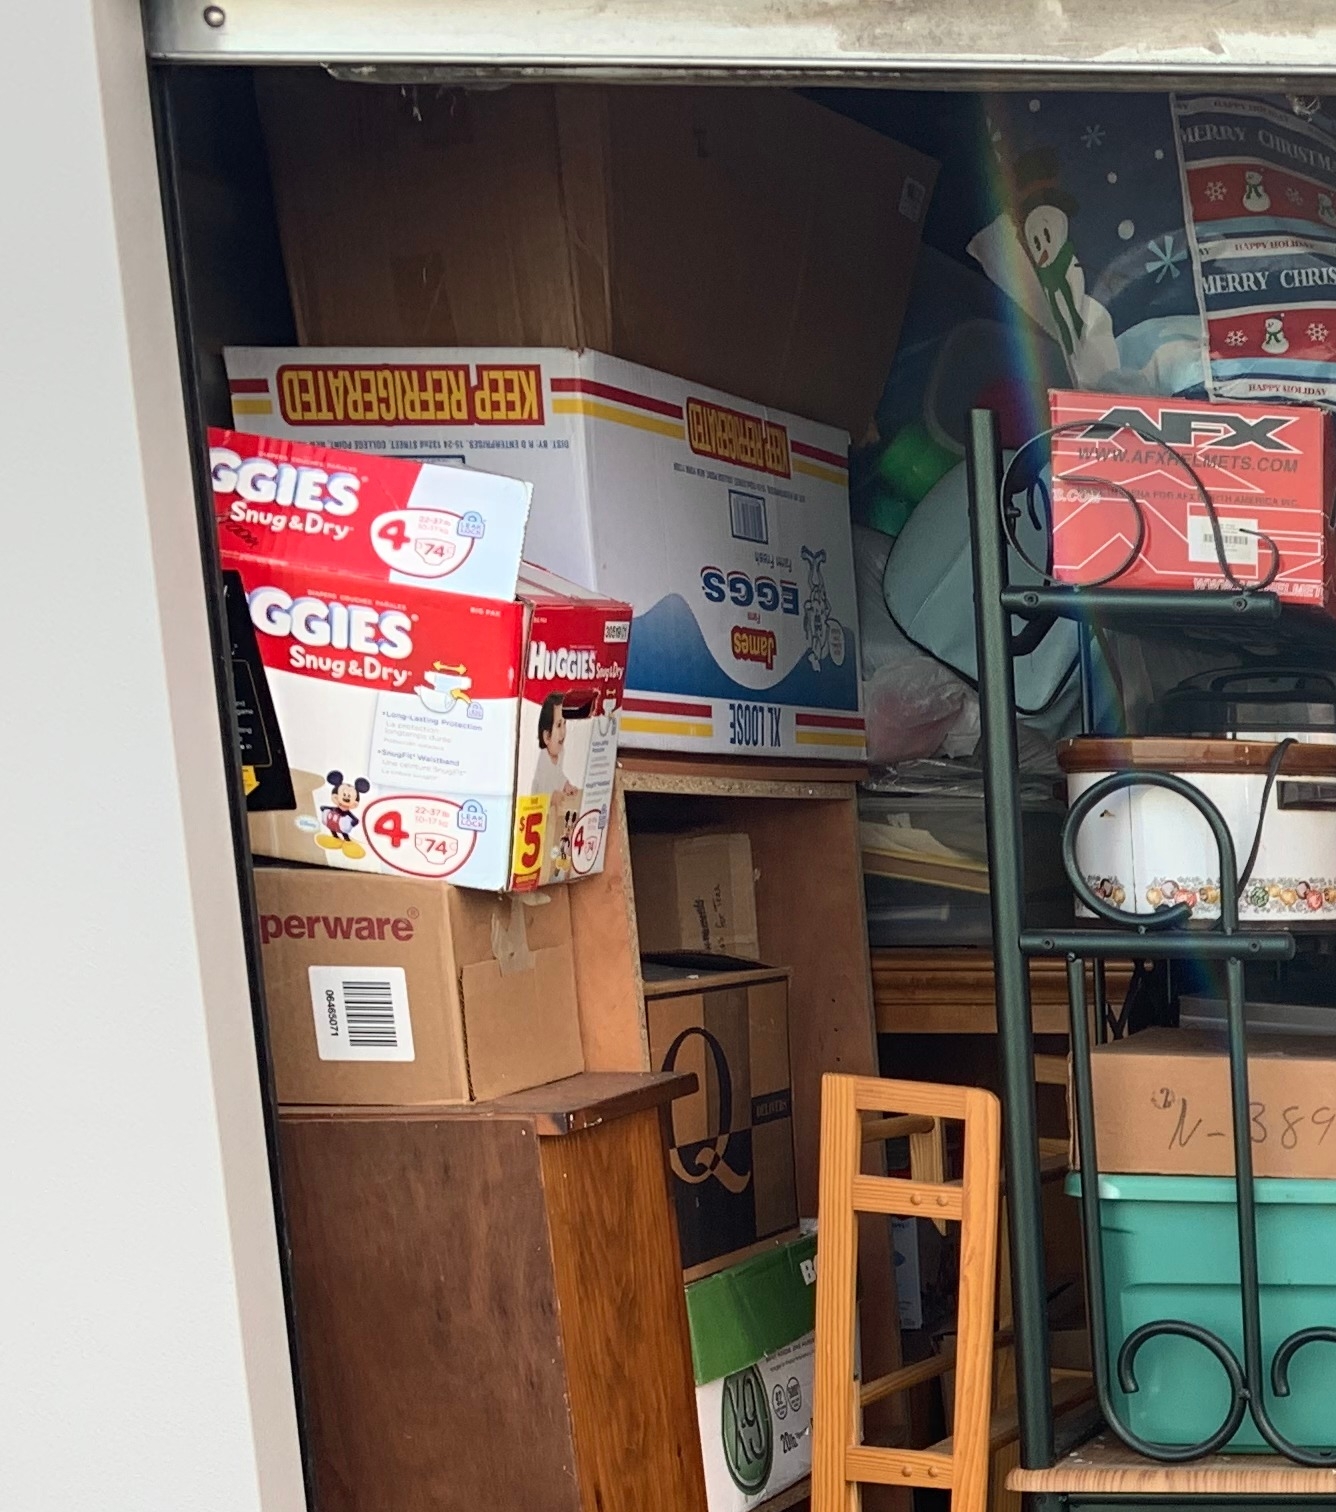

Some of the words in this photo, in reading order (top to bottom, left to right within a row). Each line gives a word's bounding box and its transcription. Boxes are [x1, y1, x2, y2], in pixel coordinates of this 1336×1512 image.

[1202, 271, 1269, 295] MERRY
[282, 369, 469, 420] REFRIGERATED
[473, 369, 540, 420] KEEP
[1079, 406, 1303, 454] AFX
[376, 518, 410, 551] 4
[424, 542, 446, 558] 74
[701, 566, 800, 616] EGGS
[246, 585, 413, 660] GGIES
[528, 641, 596, 681] HUGGIES
[733, 627, 774, 670] James
[729, 703, 765, 746] LOOSE
[767, 706, 781, 747] XL
[373, 810, 409, 849] 4
[460, 812, 484, 823] LEAK
[425, 837, 448, 854] 74
[324, 989, 339, 1037] 06465071
